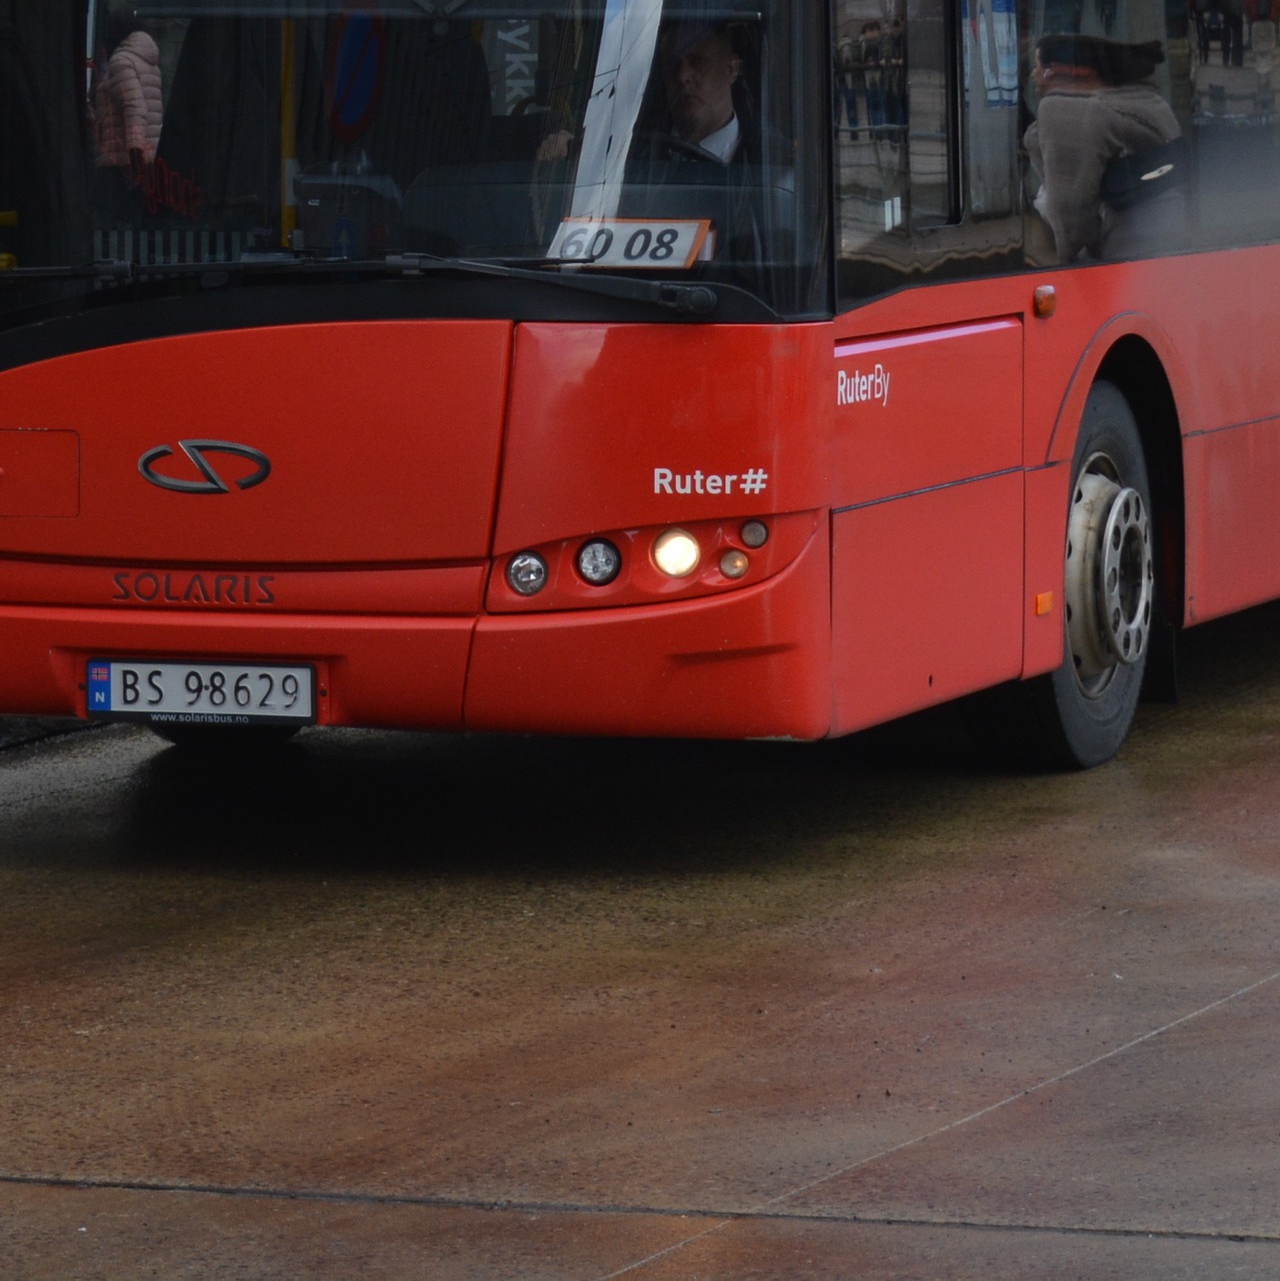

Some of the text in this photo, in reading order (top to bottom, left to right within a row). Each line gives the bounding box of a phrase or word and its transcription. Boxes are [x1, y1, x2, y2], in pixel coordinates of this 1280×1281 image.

[559, 227, 679, 261] 60 08
[837, 363, 890, 407] RuterBy
[653, 467, 769, 495] Ruter#
[111, 571, 276, 606] SOLARIS
[94, 691, 106, 703] N
[121, 668, 300, 710] BS 98629
[150, 711, 249, 724] www.solarisbus.no
